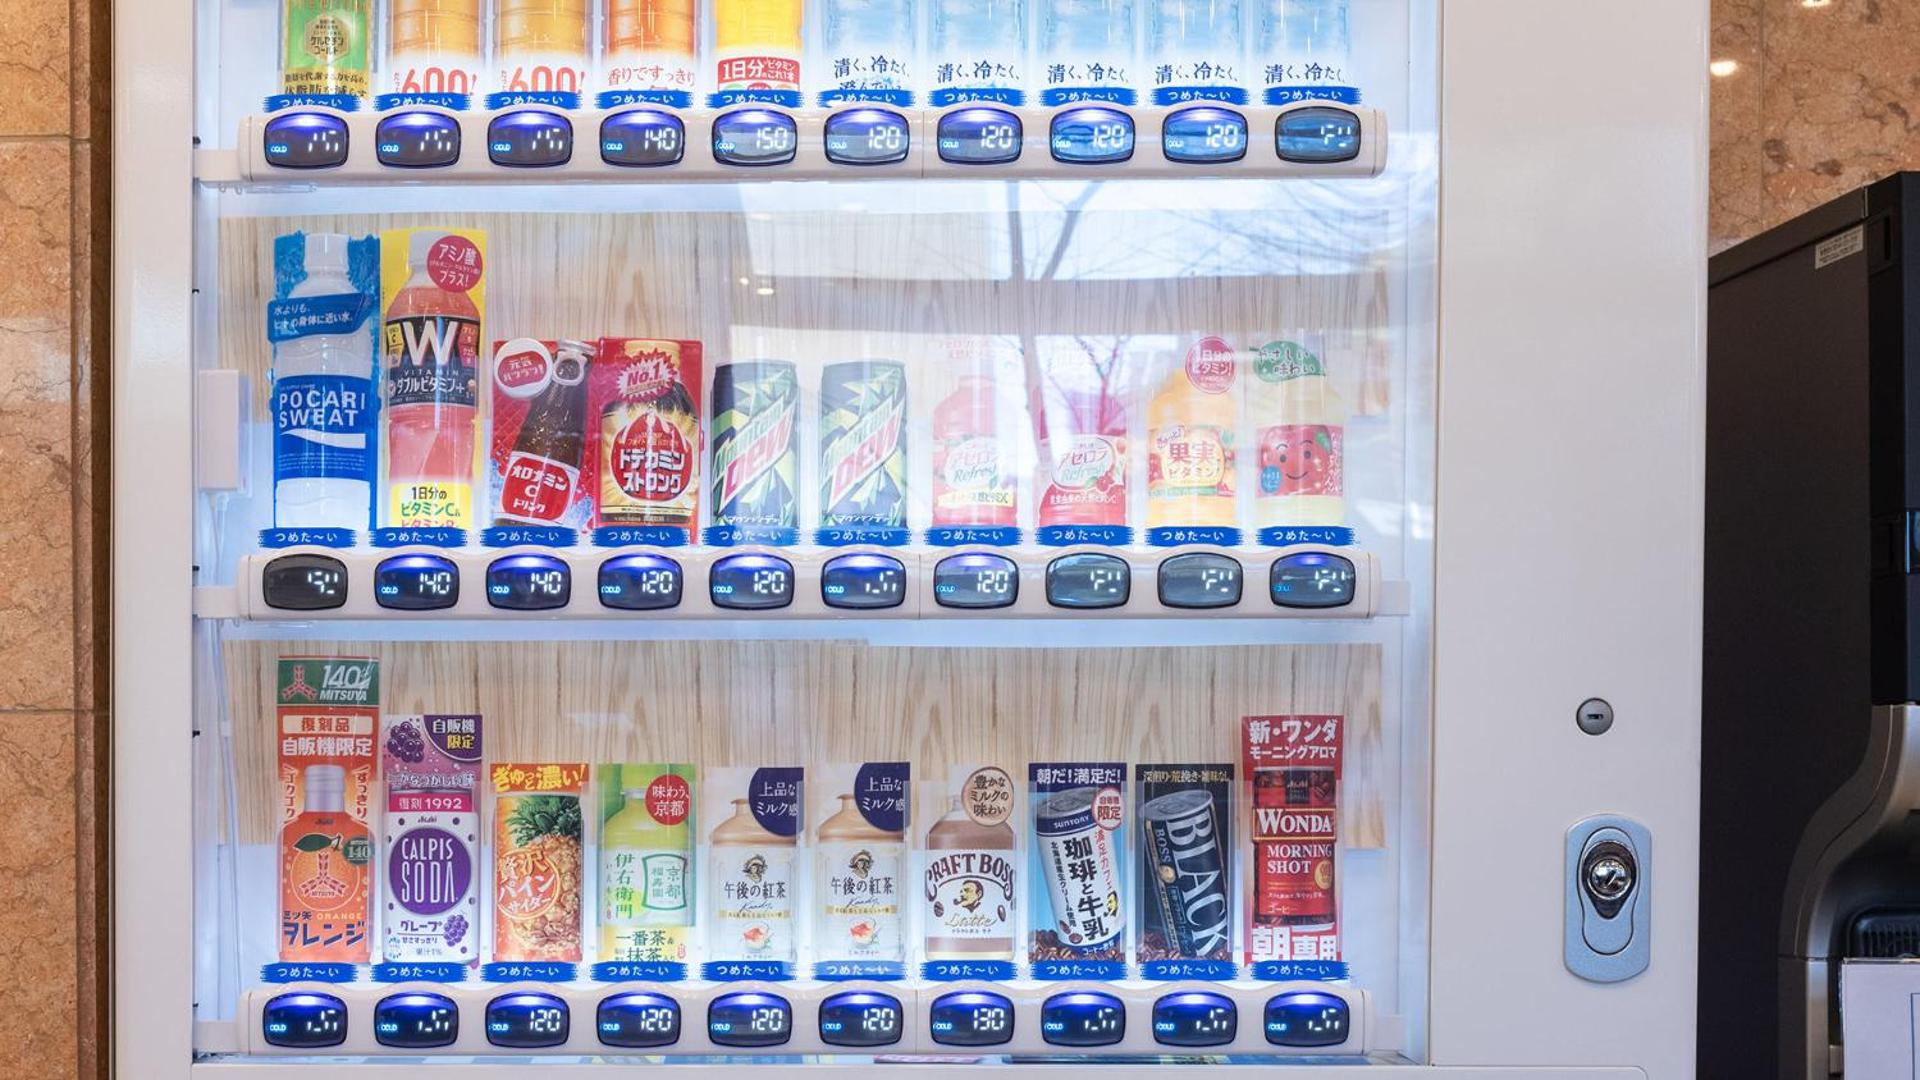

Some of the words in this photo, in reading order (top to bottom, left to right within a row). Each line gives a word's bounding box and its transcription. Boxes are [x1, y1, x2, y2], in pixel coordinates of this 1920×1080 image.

[644, 128, 676, 150] 140
[756, 127, 788, 150] 150
[868, 126, 900, 149] 120
[981, 126, 1013, 149] 120
[1093, 125, 1125, 148] 120
[1206, 124, 1238, 147] 120
[402, 320, 458, 367] W
[627, 361, 660, 387] No.1
[279, 390, 366, 411] POCARI
[279, 409, 358, 429] SWEAT
[620, 447, 685, 471] ドデカミン
[1168, 440, 1217, 464] 果実
[511, 464, 567, 491] オロナミン
[412, 487, 448, 500] 1日分の
[512, 498, 546, 513] ドリンク
[419, 572, 450, 594] 140
[530, 571, 562, 594] 140
[642, 571, 673, 594] 120
[753, 571, 785, 594] 120
[976, 570, 1008, 594] 120
[319, 689, 368, 701] MITSUYA
[447, 734, 474, 749] 限定
[1250, 719, 1338, 744] 新・ワンダ
[283, 736, 373, 756] 自販機限定
[1249, 745, 1337, 759] モーニングアロマ
[424, 798, 462, 809] 1992
[654, 800, 684, 817] 京都
[1256, 808, 1333, 835] WONDA
[401, 837, 454, 861] CALPIS
[1155, 829, 1171, 863] BOSS
[1267, 844, 1332, 858] MORNING
[979, 854, 1014, 902] BOSS
[1267, 860, 1312, 873] SHOT
[401, 860, 457, 904] SODA
[724, 881, 787, 900] 午後の紅茶
[831, 876, 894, 896] 午後の紅茶
[1063, 836, 1109, 940] 珈琲と牛乳
[1166, 809, 1228, 957] BLACK
[316, 912, 363, 921] ORANGE
[530, 1009, 561, 1032] 120
[640, 1009, 672, 1032] 120
[751, 1008, 782, 1031] 120
[863, 1008, 894, 1031] 120
[973, 1008, 1005, 1030] 130
